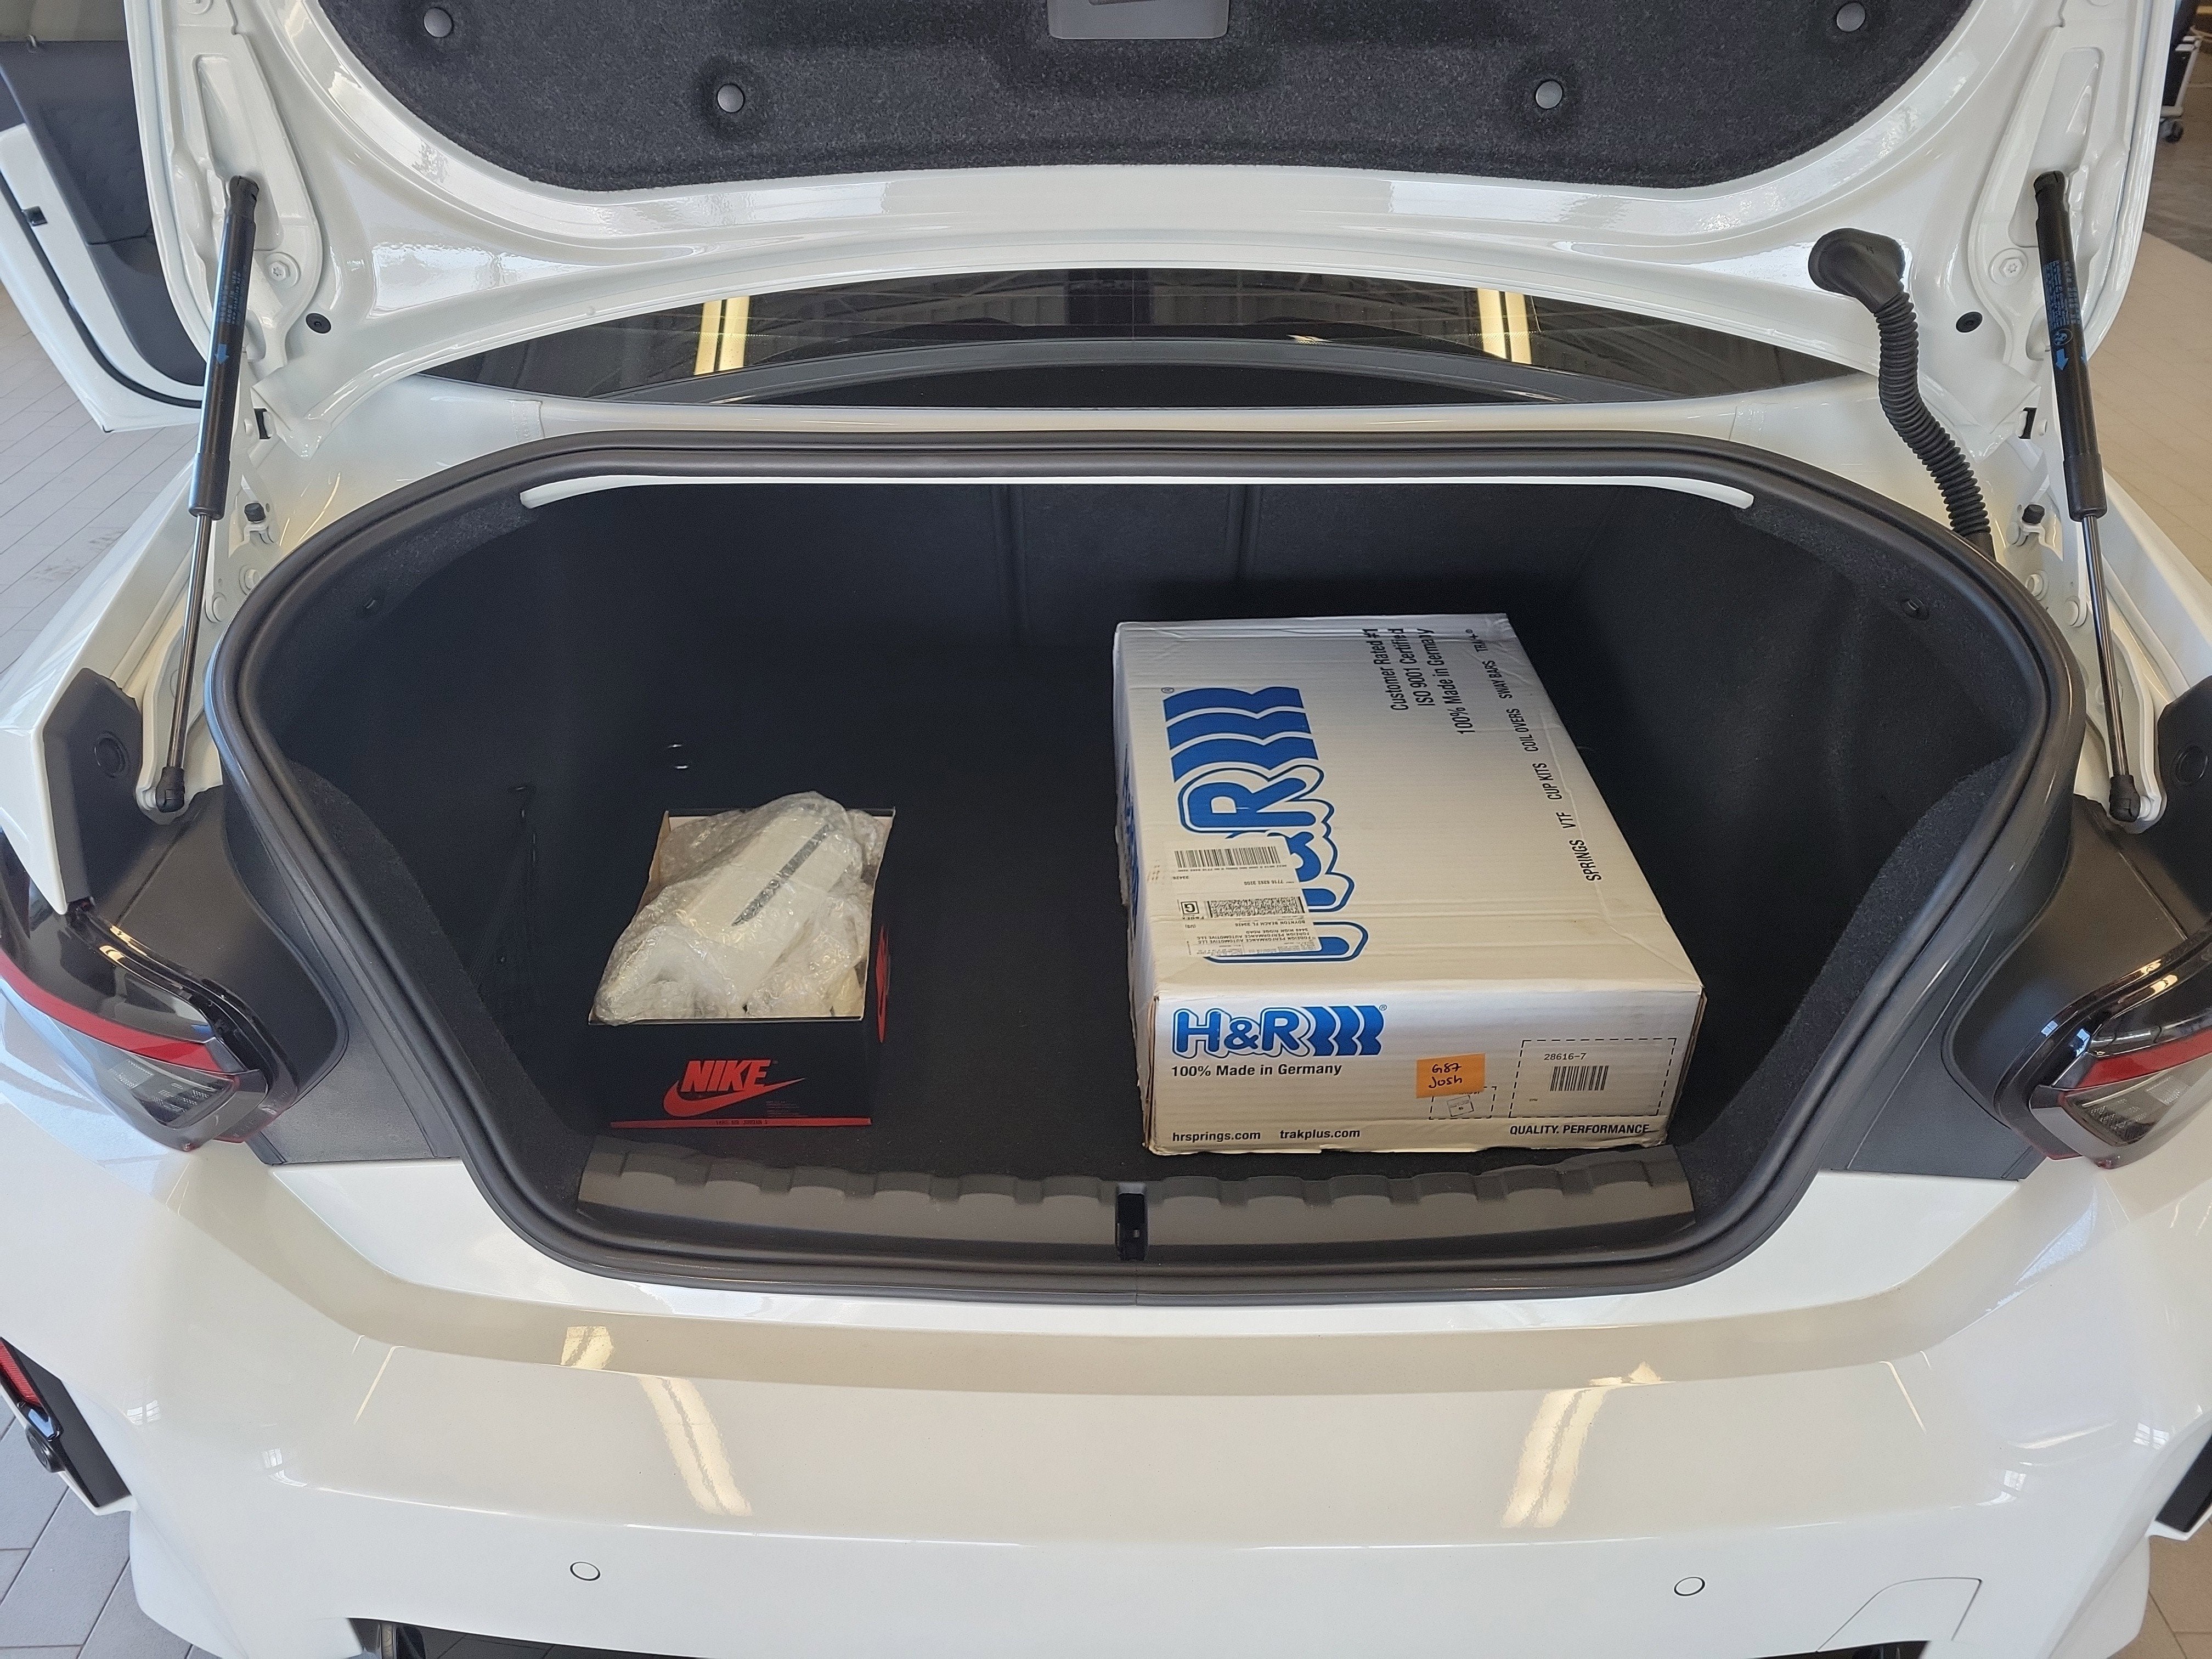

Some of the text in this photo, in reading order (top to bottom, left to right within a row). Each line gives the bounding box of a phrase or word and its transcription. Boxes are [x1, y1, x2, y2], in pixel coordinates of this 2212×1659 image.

[1366, 641, 1391, 664] Rated
[1387, 628, 1435, 706] ISO 9001 Certified
[1482, 661, 1502, 678] BARS
[1380, 667, 1408, 710] Customer
[1417, 629, 1475, 734] 100% Made in Germany
[1491, 680, 1513, 699] SWAY
[1506, 708, 1530, 732] OVERS
[1519, 734, 1539, 752] COIL
[1532, 763, 1554, 781] KITS
[1542, 783, 1562, 800] CUP
[1556, 812, 1576, 828] VTF
[1568, 839, 1602, 881] SPRINGS
[1184, 903, 1195, 913] G
[1173, 1007, 1311, 1059] H&R
[680, 1060, 771, 1092] NIKE
[1171, 1064, 1342, 1077] 100% Made in Germany
[1429, 1076, 1463, 1089] Josh
[1172, 1129, 1361, 1142] hrsprings.com trakplus.com
[1510, 1124, 1650, 1135] QUALITY. PERFORMANCE
